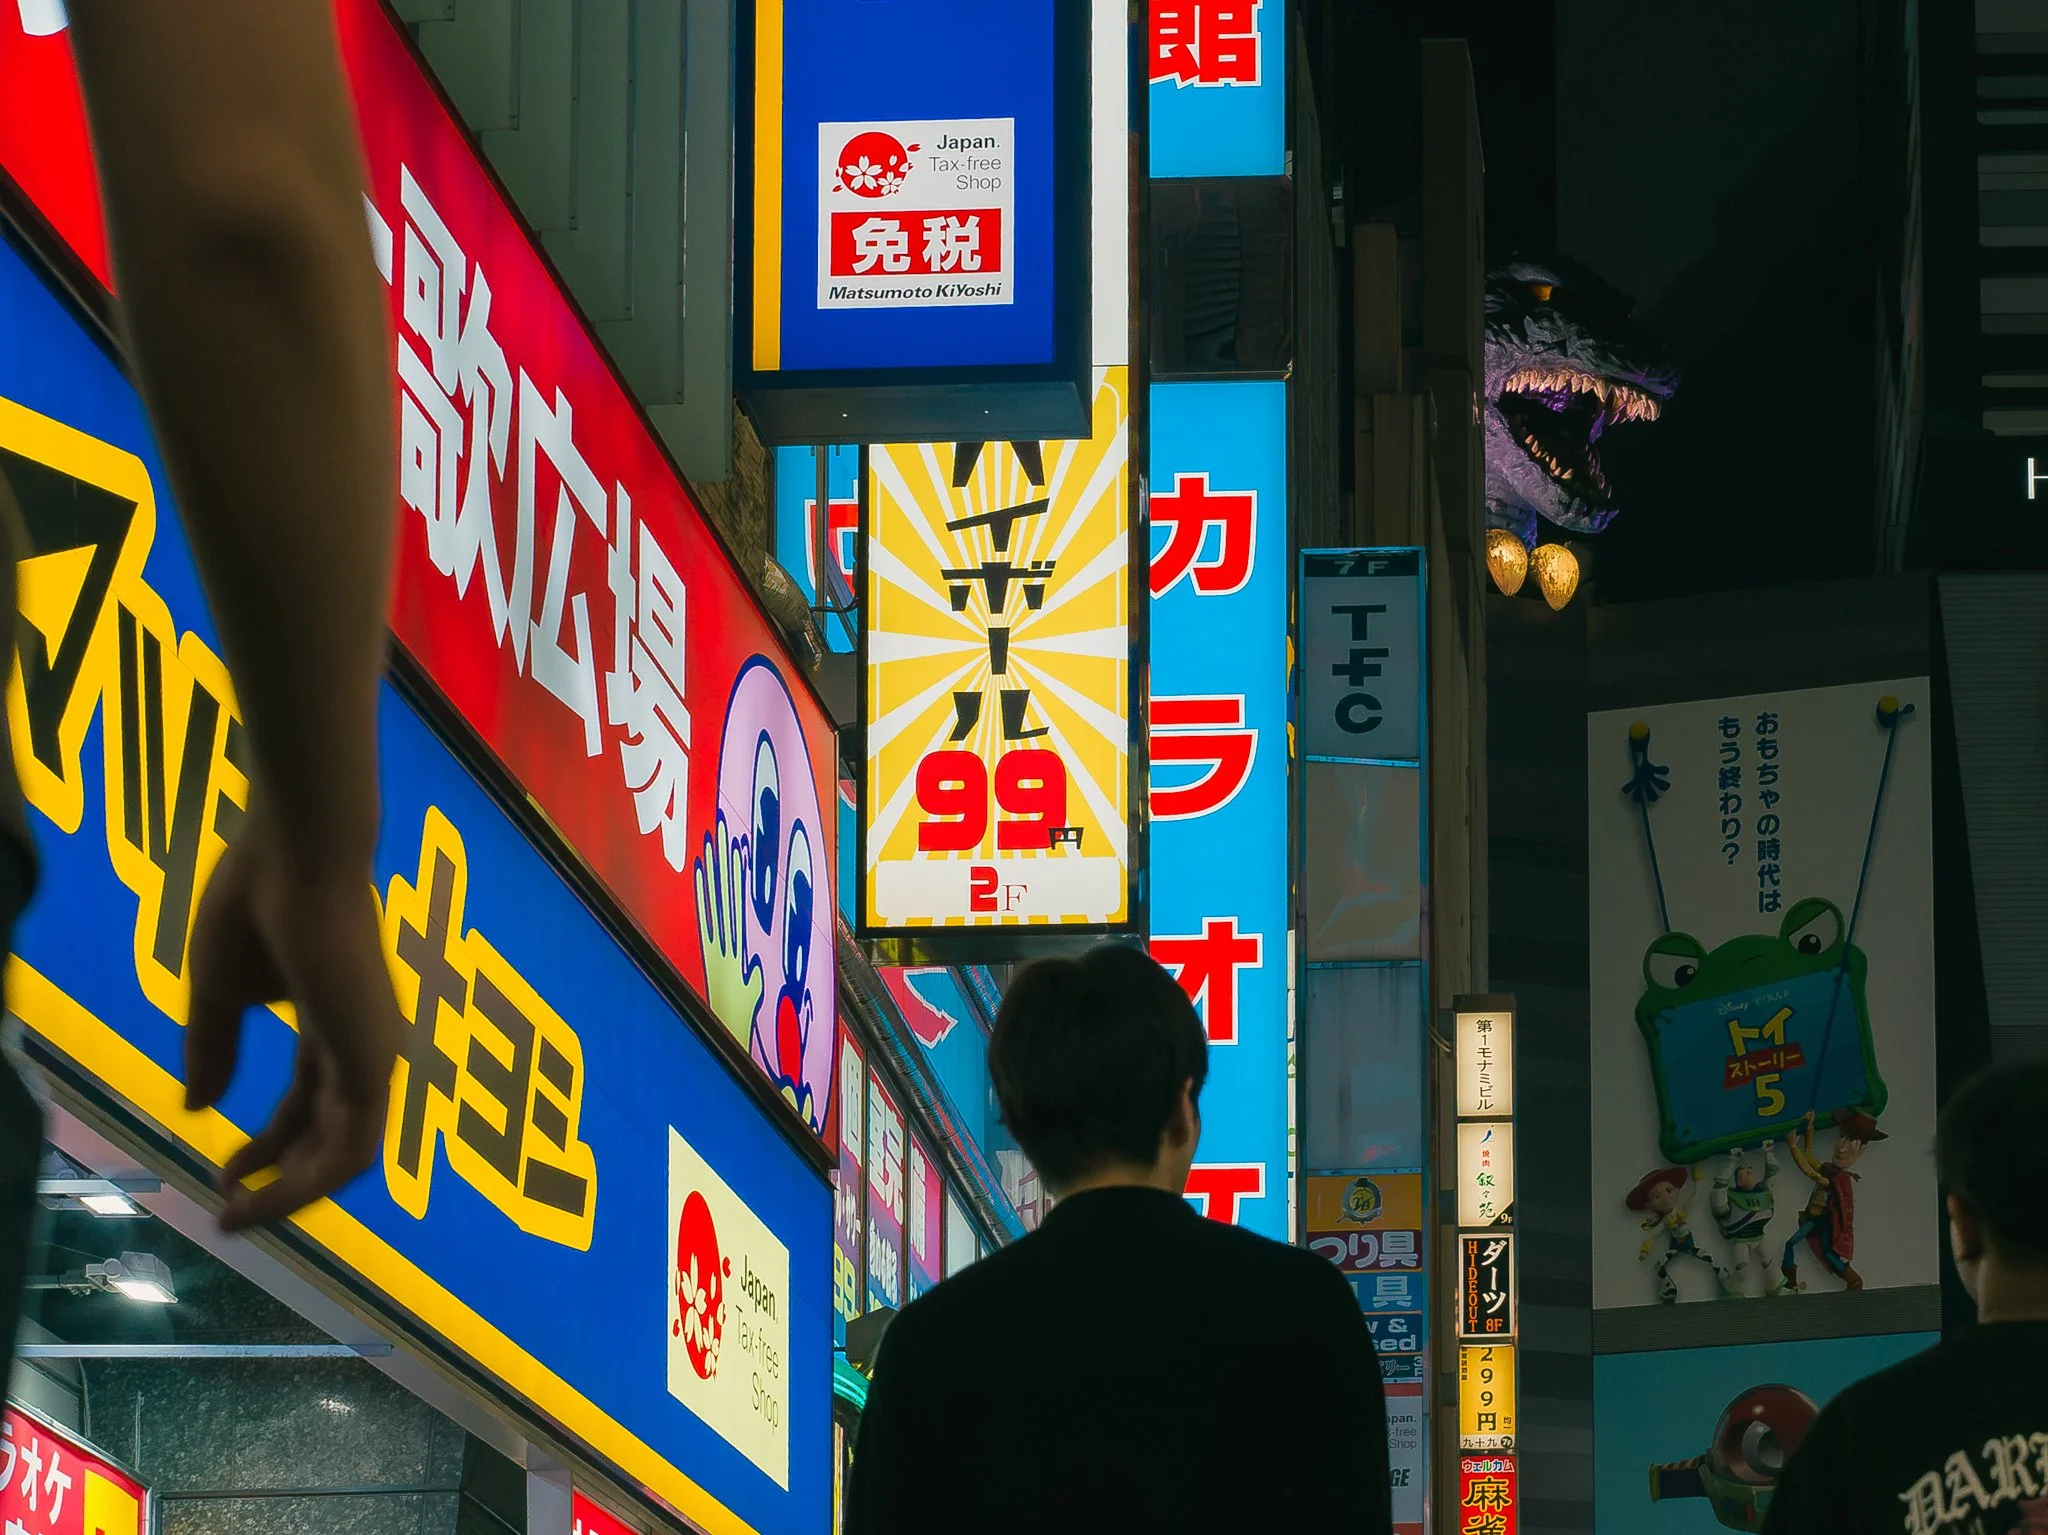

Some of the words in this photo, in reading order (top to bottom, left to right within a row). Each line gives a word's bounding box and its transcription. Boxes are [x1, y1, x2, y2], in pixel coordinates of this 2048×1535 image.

[929, 156, 1002, 172] Tax-free
[936, 134, 1001, 153] Japan.
[956, 174, 1002, 192] Shop
[851, 215, 982, 274] 免税
[828, 286, 933, 300] Matsumoto
[935, 282, 1002, 298] KiYoshi
[1334, 560, 1389, 575] 7F
[1331, 604, 1390, 734] TFC
[1718, 716, 1743, 865] もう終わり？
[1755, 711, 1782, 914] おもちゃの時代は
[969, 866, 1028, 912] 2F
[1728, 1007, 1793, 1057] トイ
[1476, 1019, 1494, 1111] 第1モナミビル
[1728, 1051, 1801, 1079] ストーリー
[1755, 1073, 1786, 1117] 5
[1500, 1212, 1513, 1224] 9F
[1309, 1231, 1419, 1269] つり具
[740, 1255, 780, 1324] Japan.
[1468, 1241, 1479, 1333] HIDEOUT
[1481, 1240, 1508, 1314] ダーツ
[735, 1304, 780, 1380] Tax-free
[1485, 1318, 1503, 1333] 8F
[752, 1371, 780, 1435] Shop
[1461, 1459, 1515, 1474] ウェルカム
